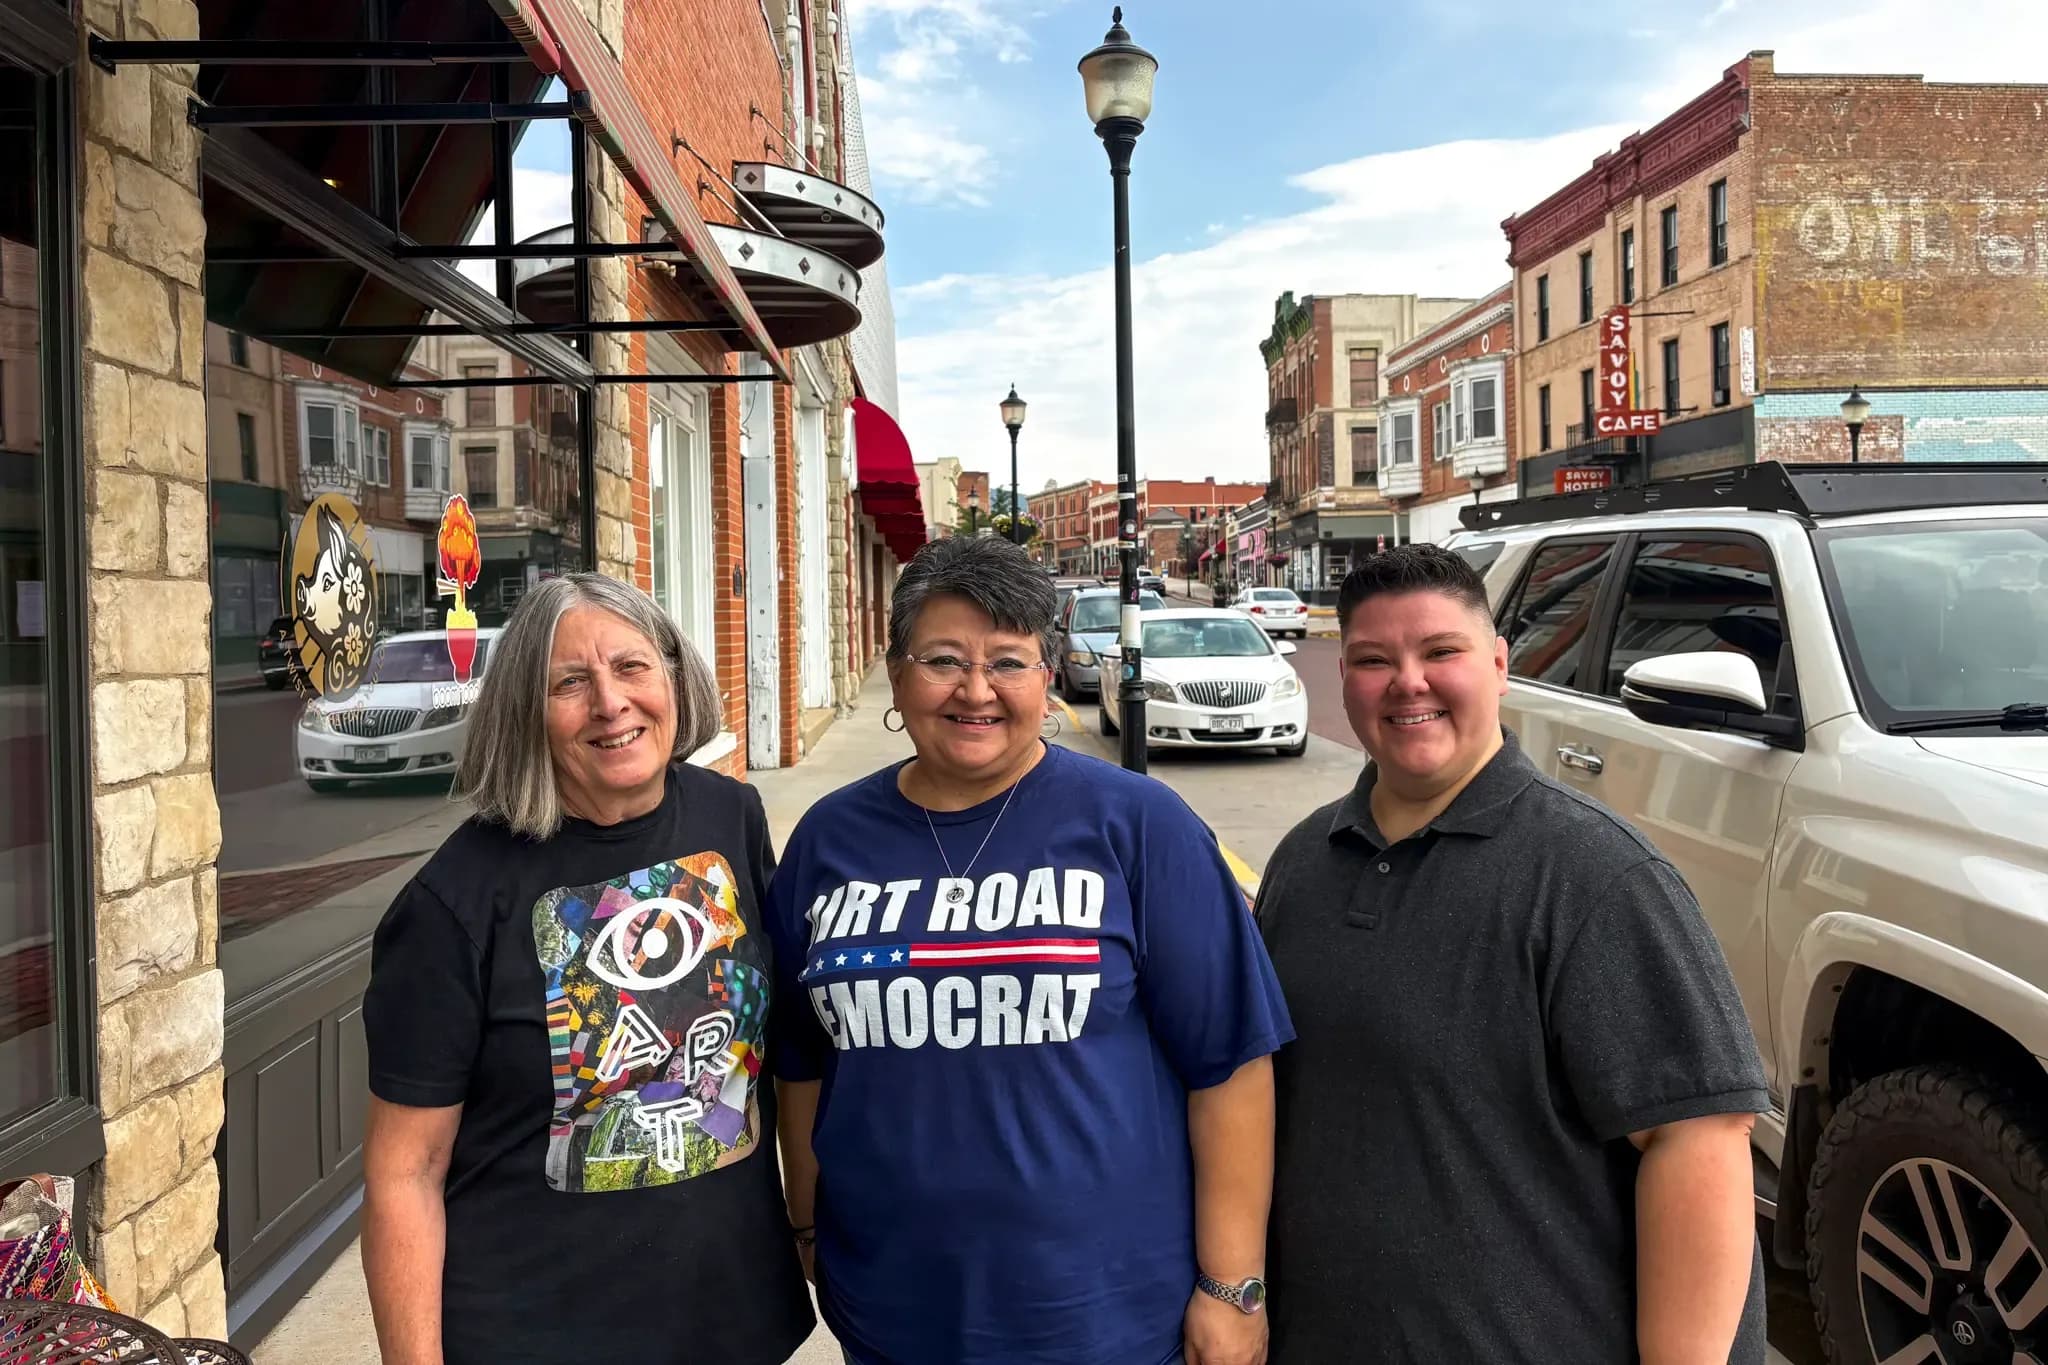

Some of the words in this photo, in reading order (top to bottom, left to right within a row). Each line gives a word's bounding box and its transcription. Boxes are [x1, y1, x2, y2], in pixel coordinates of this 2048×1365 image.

[1609, 314, 1627, 406] SAVOY
[1598, 415, 1657, 432] CAFE
[1565, 471, 1605, 480] SAVOY
[927, 867, 1104, 931] ROAD
[809, 972, 1100, 1050] EMOCRAT
